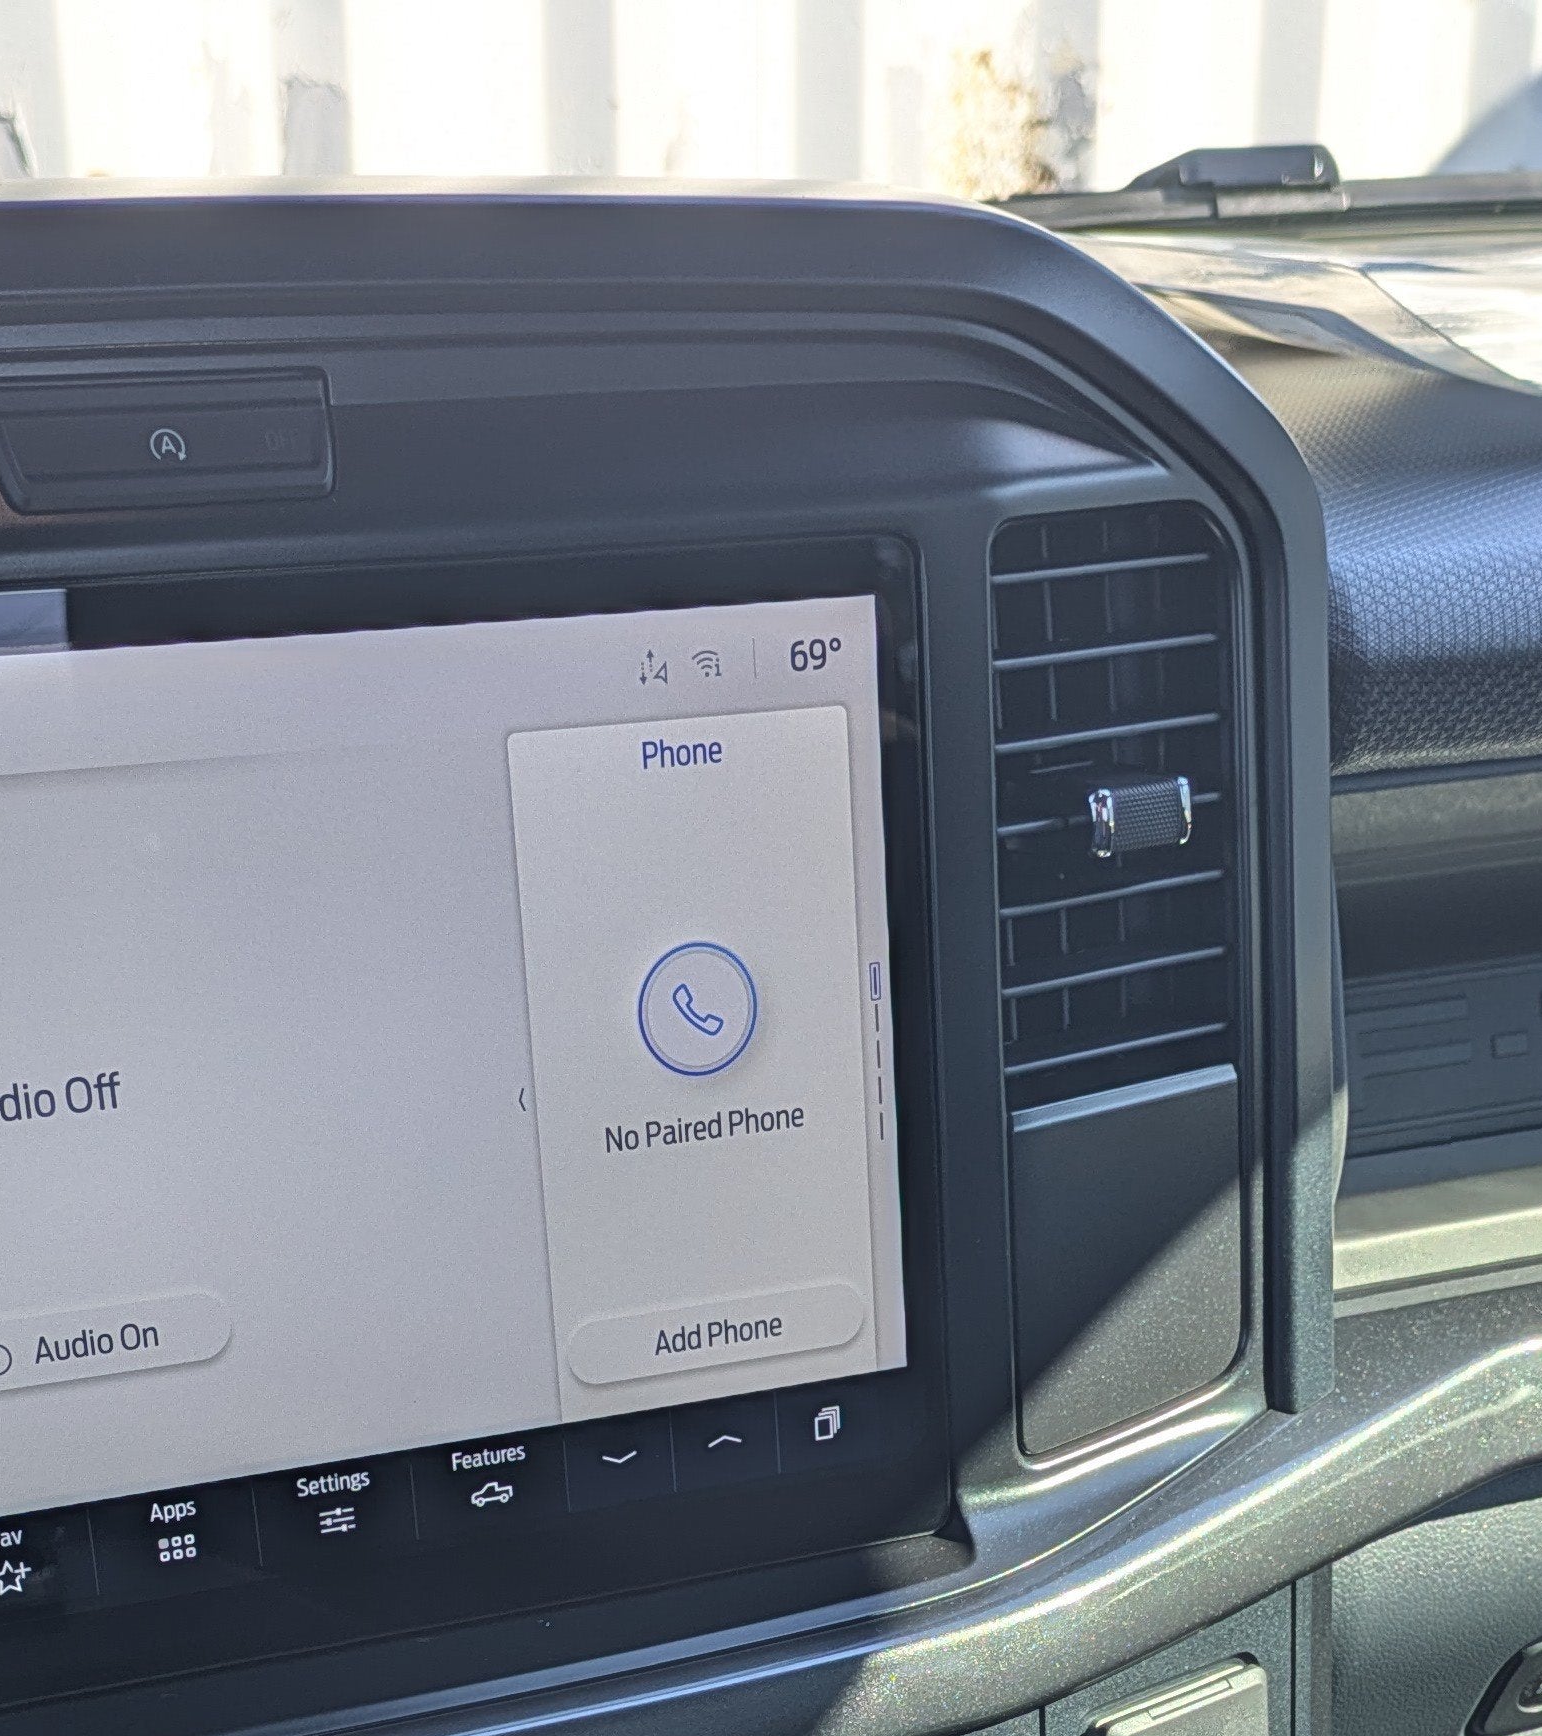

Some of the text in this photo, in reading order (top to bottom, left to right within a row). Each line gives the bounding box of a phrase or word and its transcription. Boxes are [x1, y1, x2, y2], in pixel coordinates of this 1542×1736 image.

[641, 739, 723, 770] Phone
[64, 1070, 121, 1115] Off
[605, 1105, 805, 1153] No Paired Phone
[35, 1323, 159, 1364] Audio On
[655, 1315, 783, 1356] Add Phone
[451, 1444, 526, 1472] Features
[296, 1470, 371, 1499] Settings
[150, 1500, 197, 1524] Apps
